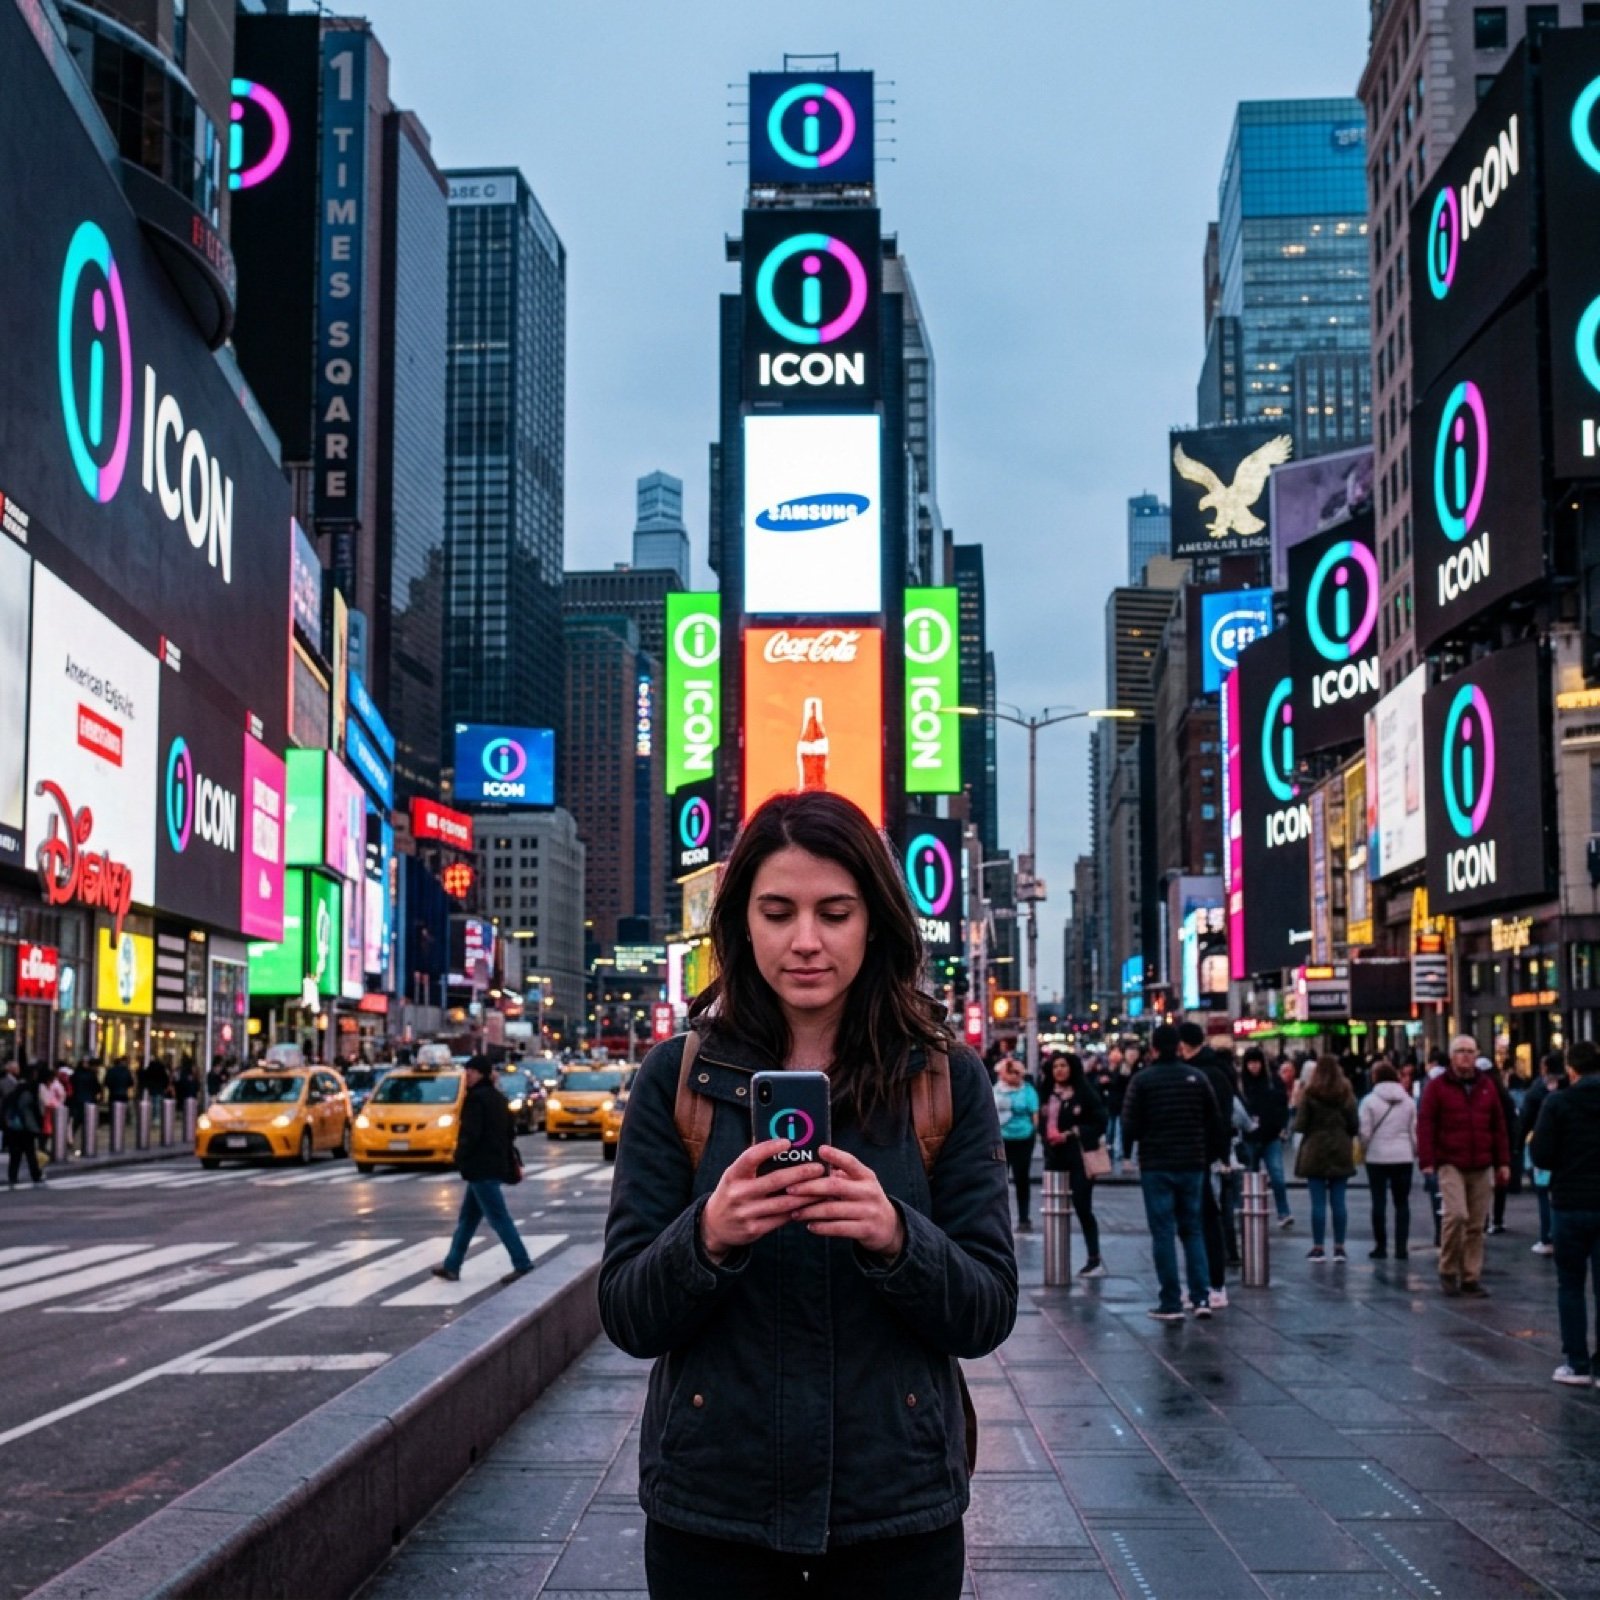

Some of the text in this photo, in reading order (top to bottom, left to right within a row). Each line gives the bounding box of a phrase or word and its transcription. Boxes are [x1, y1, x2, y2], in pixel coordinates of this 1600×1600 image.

[1460, 114, 1519, 241] ICON
[324, 51, 357, 498] 1 TIMES SQARE
[759, 353, 865, 386] ICON
[142, 364, 234, 584] ICON
[1439, 532, 1490, 607] ICON
[1312, 655, 1379, 709] ICON
[684, 680, 713, 769] ICON
[911, 677, 941, 768] ICON
[195, 773, 237, 852] ICON
[483, 782, 525, 797] ICON
[1446, 840, 1496, 893] ICON
